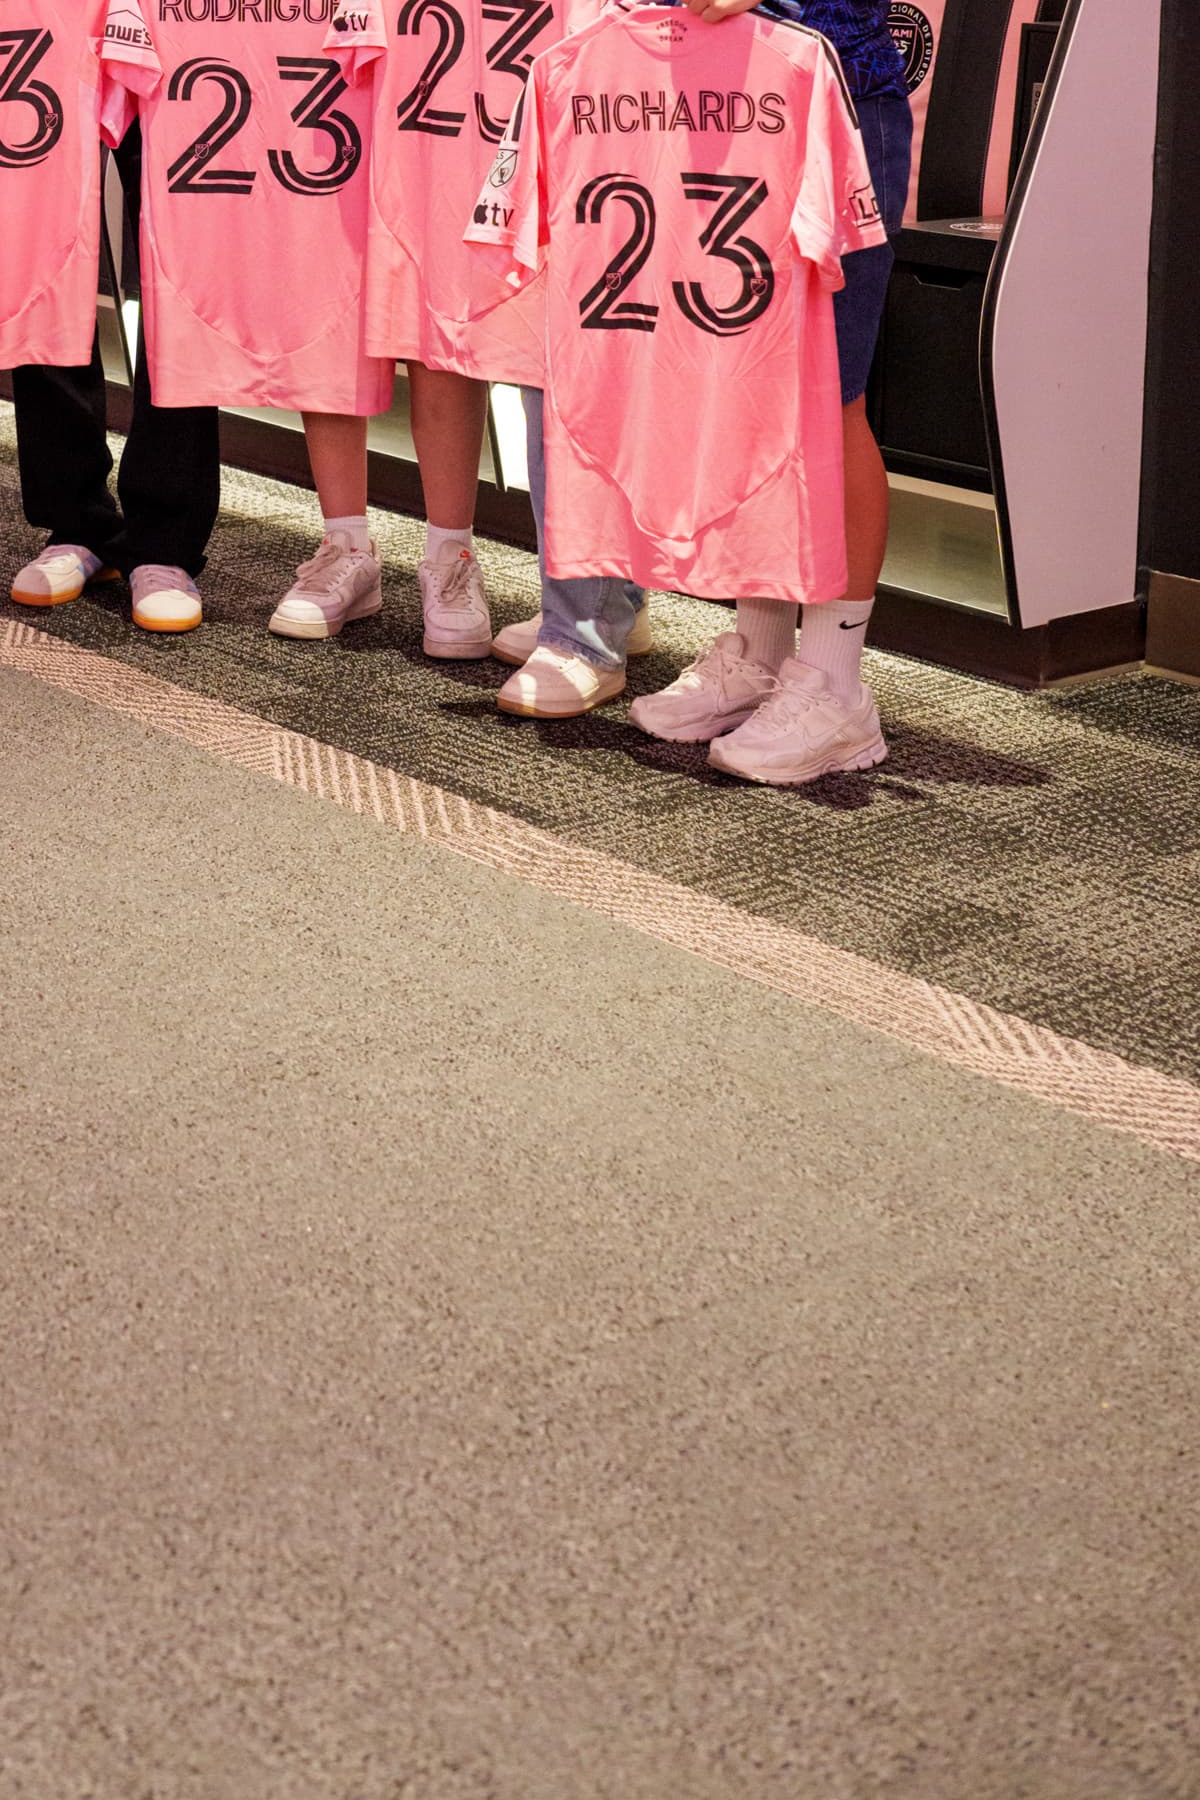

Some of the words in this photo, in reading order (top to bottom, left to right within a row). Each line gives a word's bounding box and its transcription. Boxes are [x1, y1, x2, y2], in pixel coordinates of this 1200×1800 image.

[105, 24, 153, 46] OWE'S
[349, 12, 369, 31] tv
[167, 55, 362, 196] 23
[571, 90, 786, 135] RICHARDS
[491, 202, 514, 228] tv
[575, 172, 775, 337] 23
